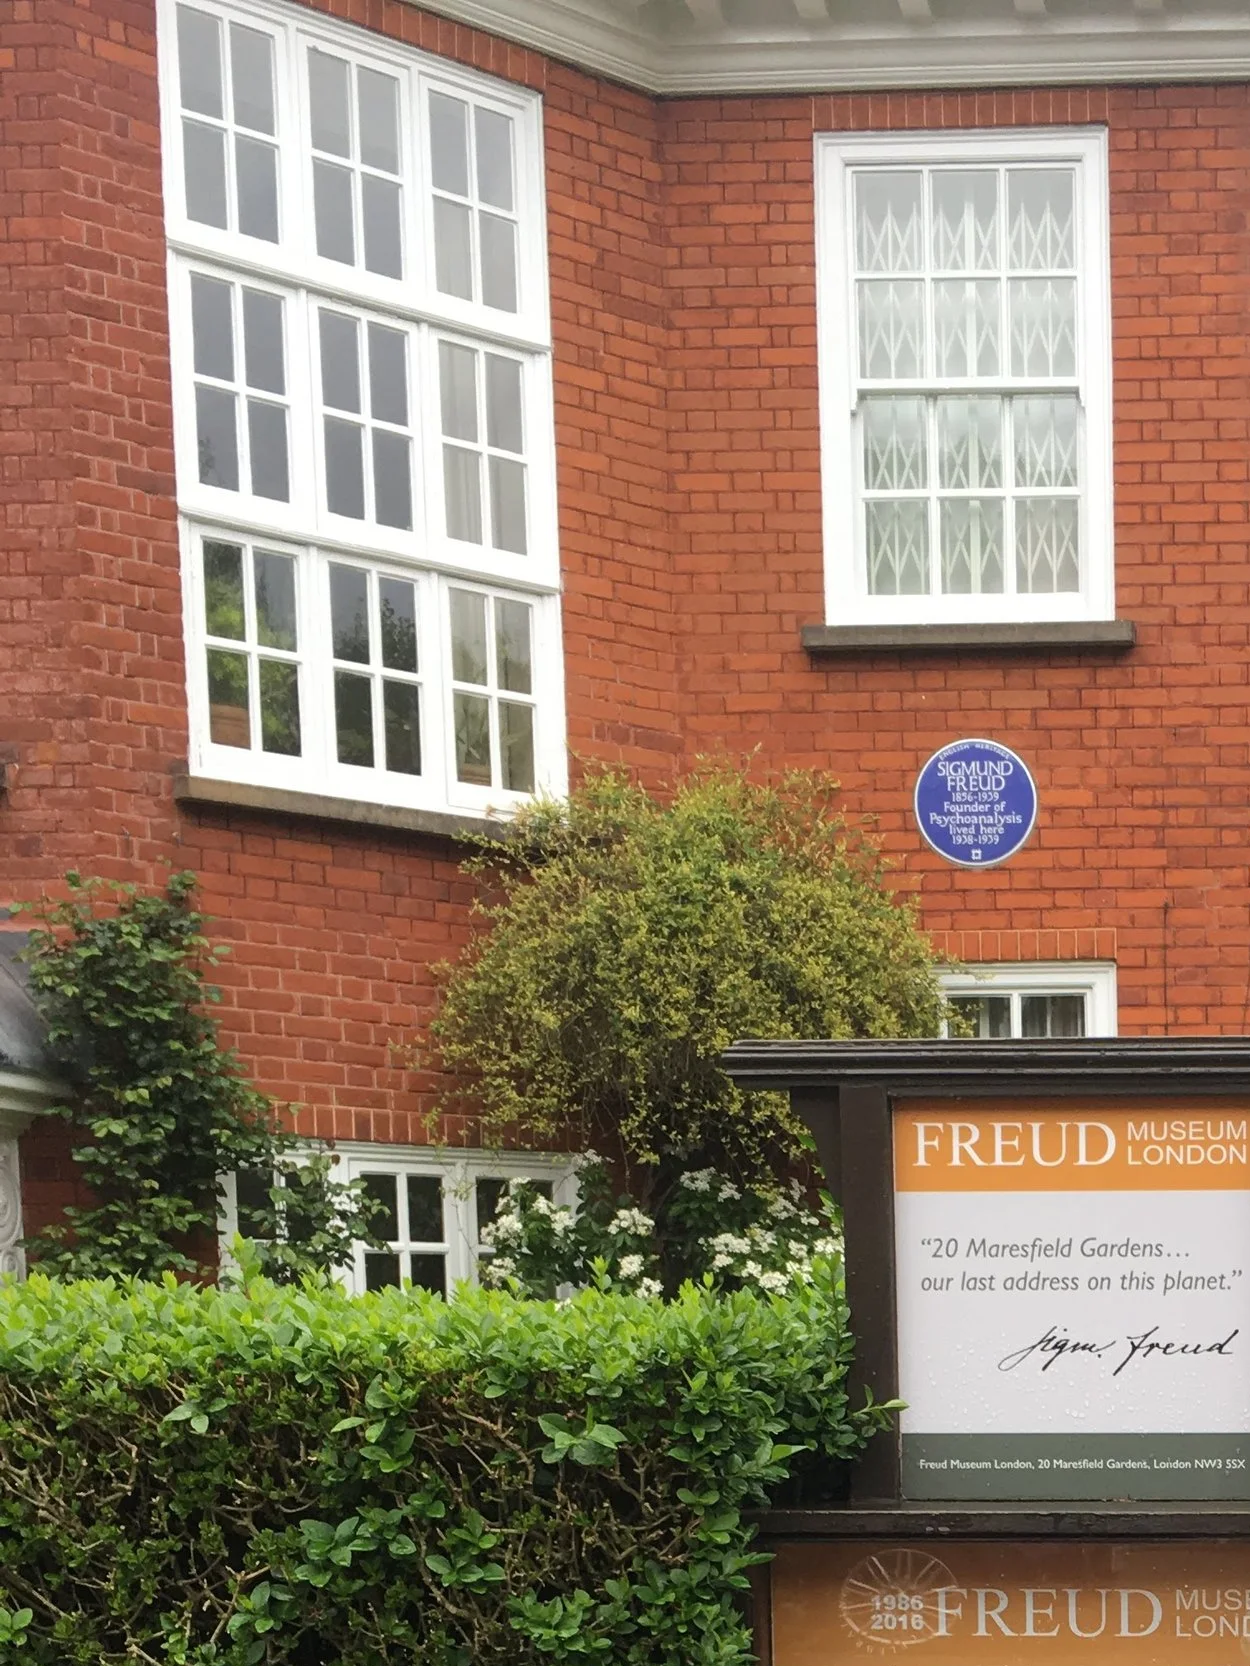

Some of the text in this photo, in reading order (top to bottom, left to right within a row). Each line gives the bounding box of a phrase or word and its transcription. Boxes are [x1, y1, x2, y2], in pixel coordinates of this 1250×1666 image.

[938, 744, 969, 761] ENGLISH
[937, 761, 1013, 776] SIGMUND
[947, 776, 1005, 791] FREUD
[952, 792, 1000, 802] 1856-1939
[944, 802, 1006, 812] Founder of
[930, 812, 1022, 827] Psychoanalysis
[949, 825, 1004, 834] lived here
[952, 835, 1000, 844] 1938-1939
[1127, 1119, 1246, 1140] MUSEUM
[912, 1121, 1115, 1166] FREUD
[1128, 1144, 1246, 1164] LONDON
[966, 1237, 1072, 1262] Maresfield
[921, 1277, 953, 1291] our
[961, 1271, 995, 1290] last
[1003, 1270, 1078, 1290] address
[1088, 1276, 1110, 1290] on
[1120, 1270, 1154, 1290] this
[919, 1458, 1245, 1469] Freud Museum London, 20 Maresfield Gardens, London NW3 5SX
[872, 1595, 923, 1611] 1986
[933, 1587, 1161, 1638] FREUD
[871, 1614, 924, 1630] 2016
